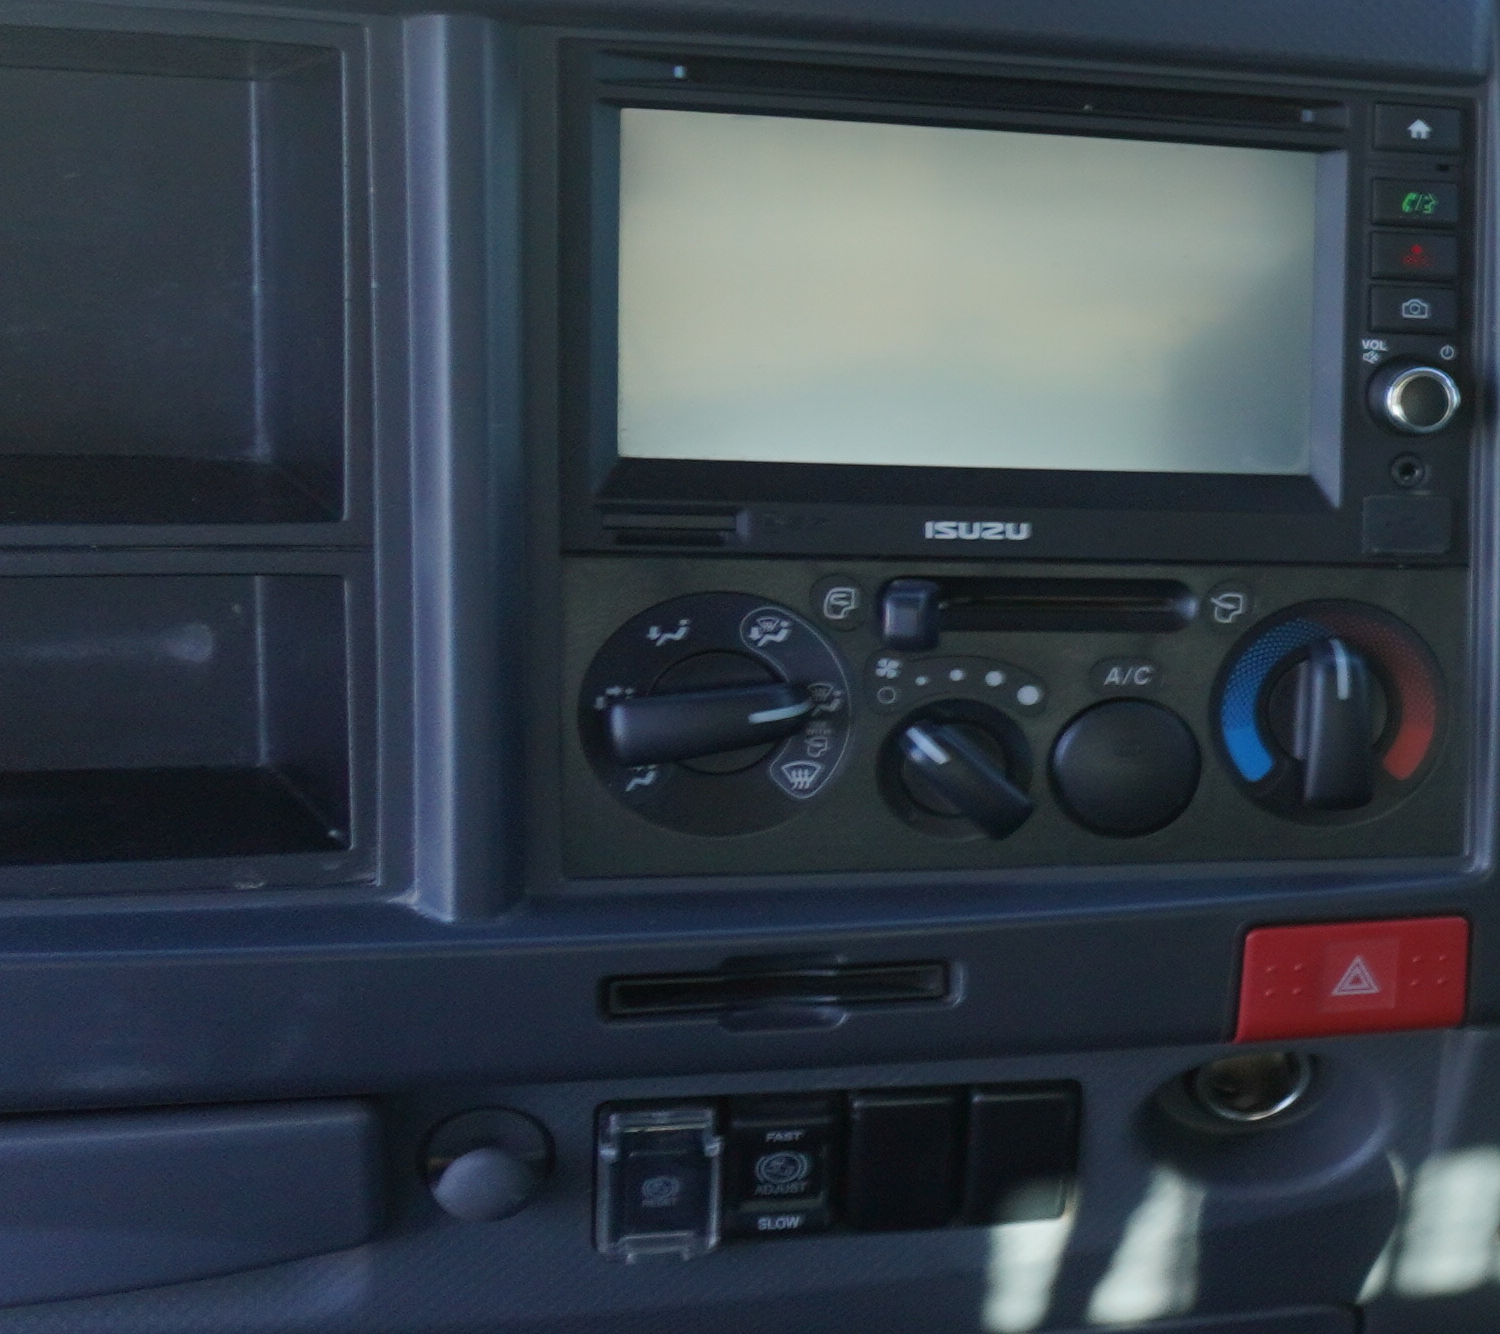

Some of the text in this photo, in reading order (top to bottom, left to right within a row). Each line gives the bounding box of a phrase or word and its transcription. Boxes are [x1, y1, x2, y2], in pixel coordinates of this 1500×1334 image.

[1361, 338, 1388, 352] VOL
[924, 520, 1032, 541] ISUZU
[1102, 666, 1155, 687] A/C
[764, 1129, 804, 1143] FAST
[754, 1181, 806, 1196] ADJUST
[757, 1215, 801, 1232] SLOW
